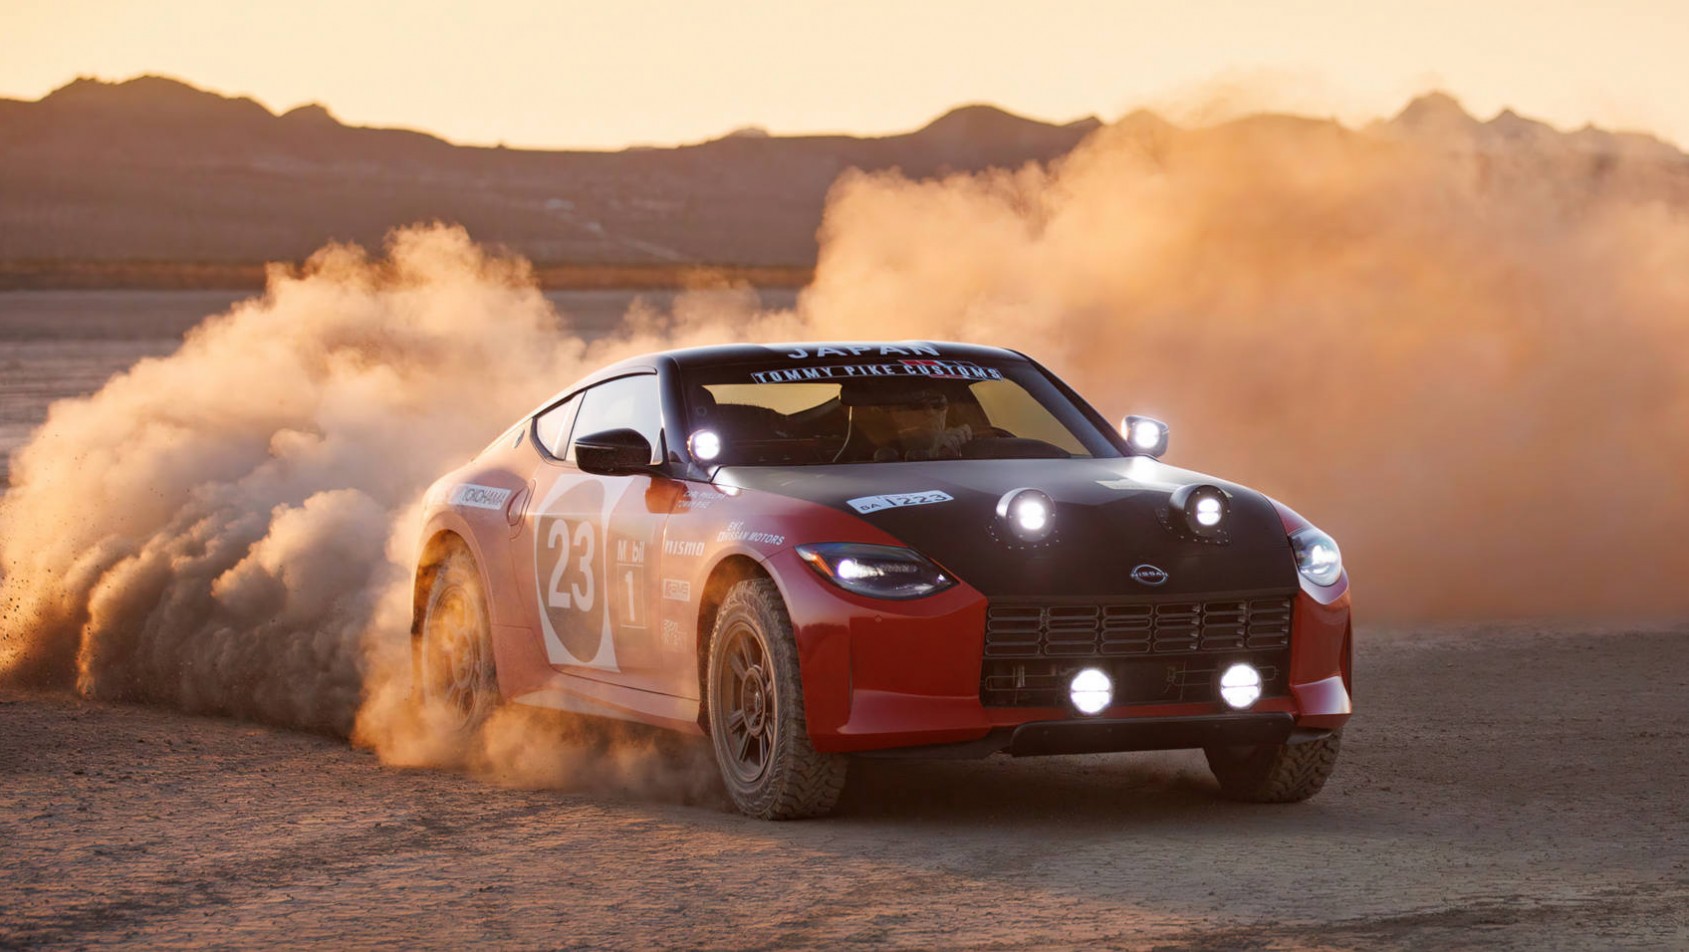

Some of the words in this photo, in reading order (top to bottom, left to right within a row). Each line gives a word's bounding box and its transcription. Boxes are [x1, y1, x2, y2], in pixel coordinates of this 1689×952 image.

[787, 345, 940, 359] JAPAN
[754, 366, 833, 383] TOMMY
[846, 364, 892, 377] PIKE
[903, 364, 1002, 380] CUSTOMS
[885, 494, 947, 506] 1223
[748, 532, 785, 546] MOTORS
[547, 519, 595, 612] 23
[625, 569, 635, 623] 1
